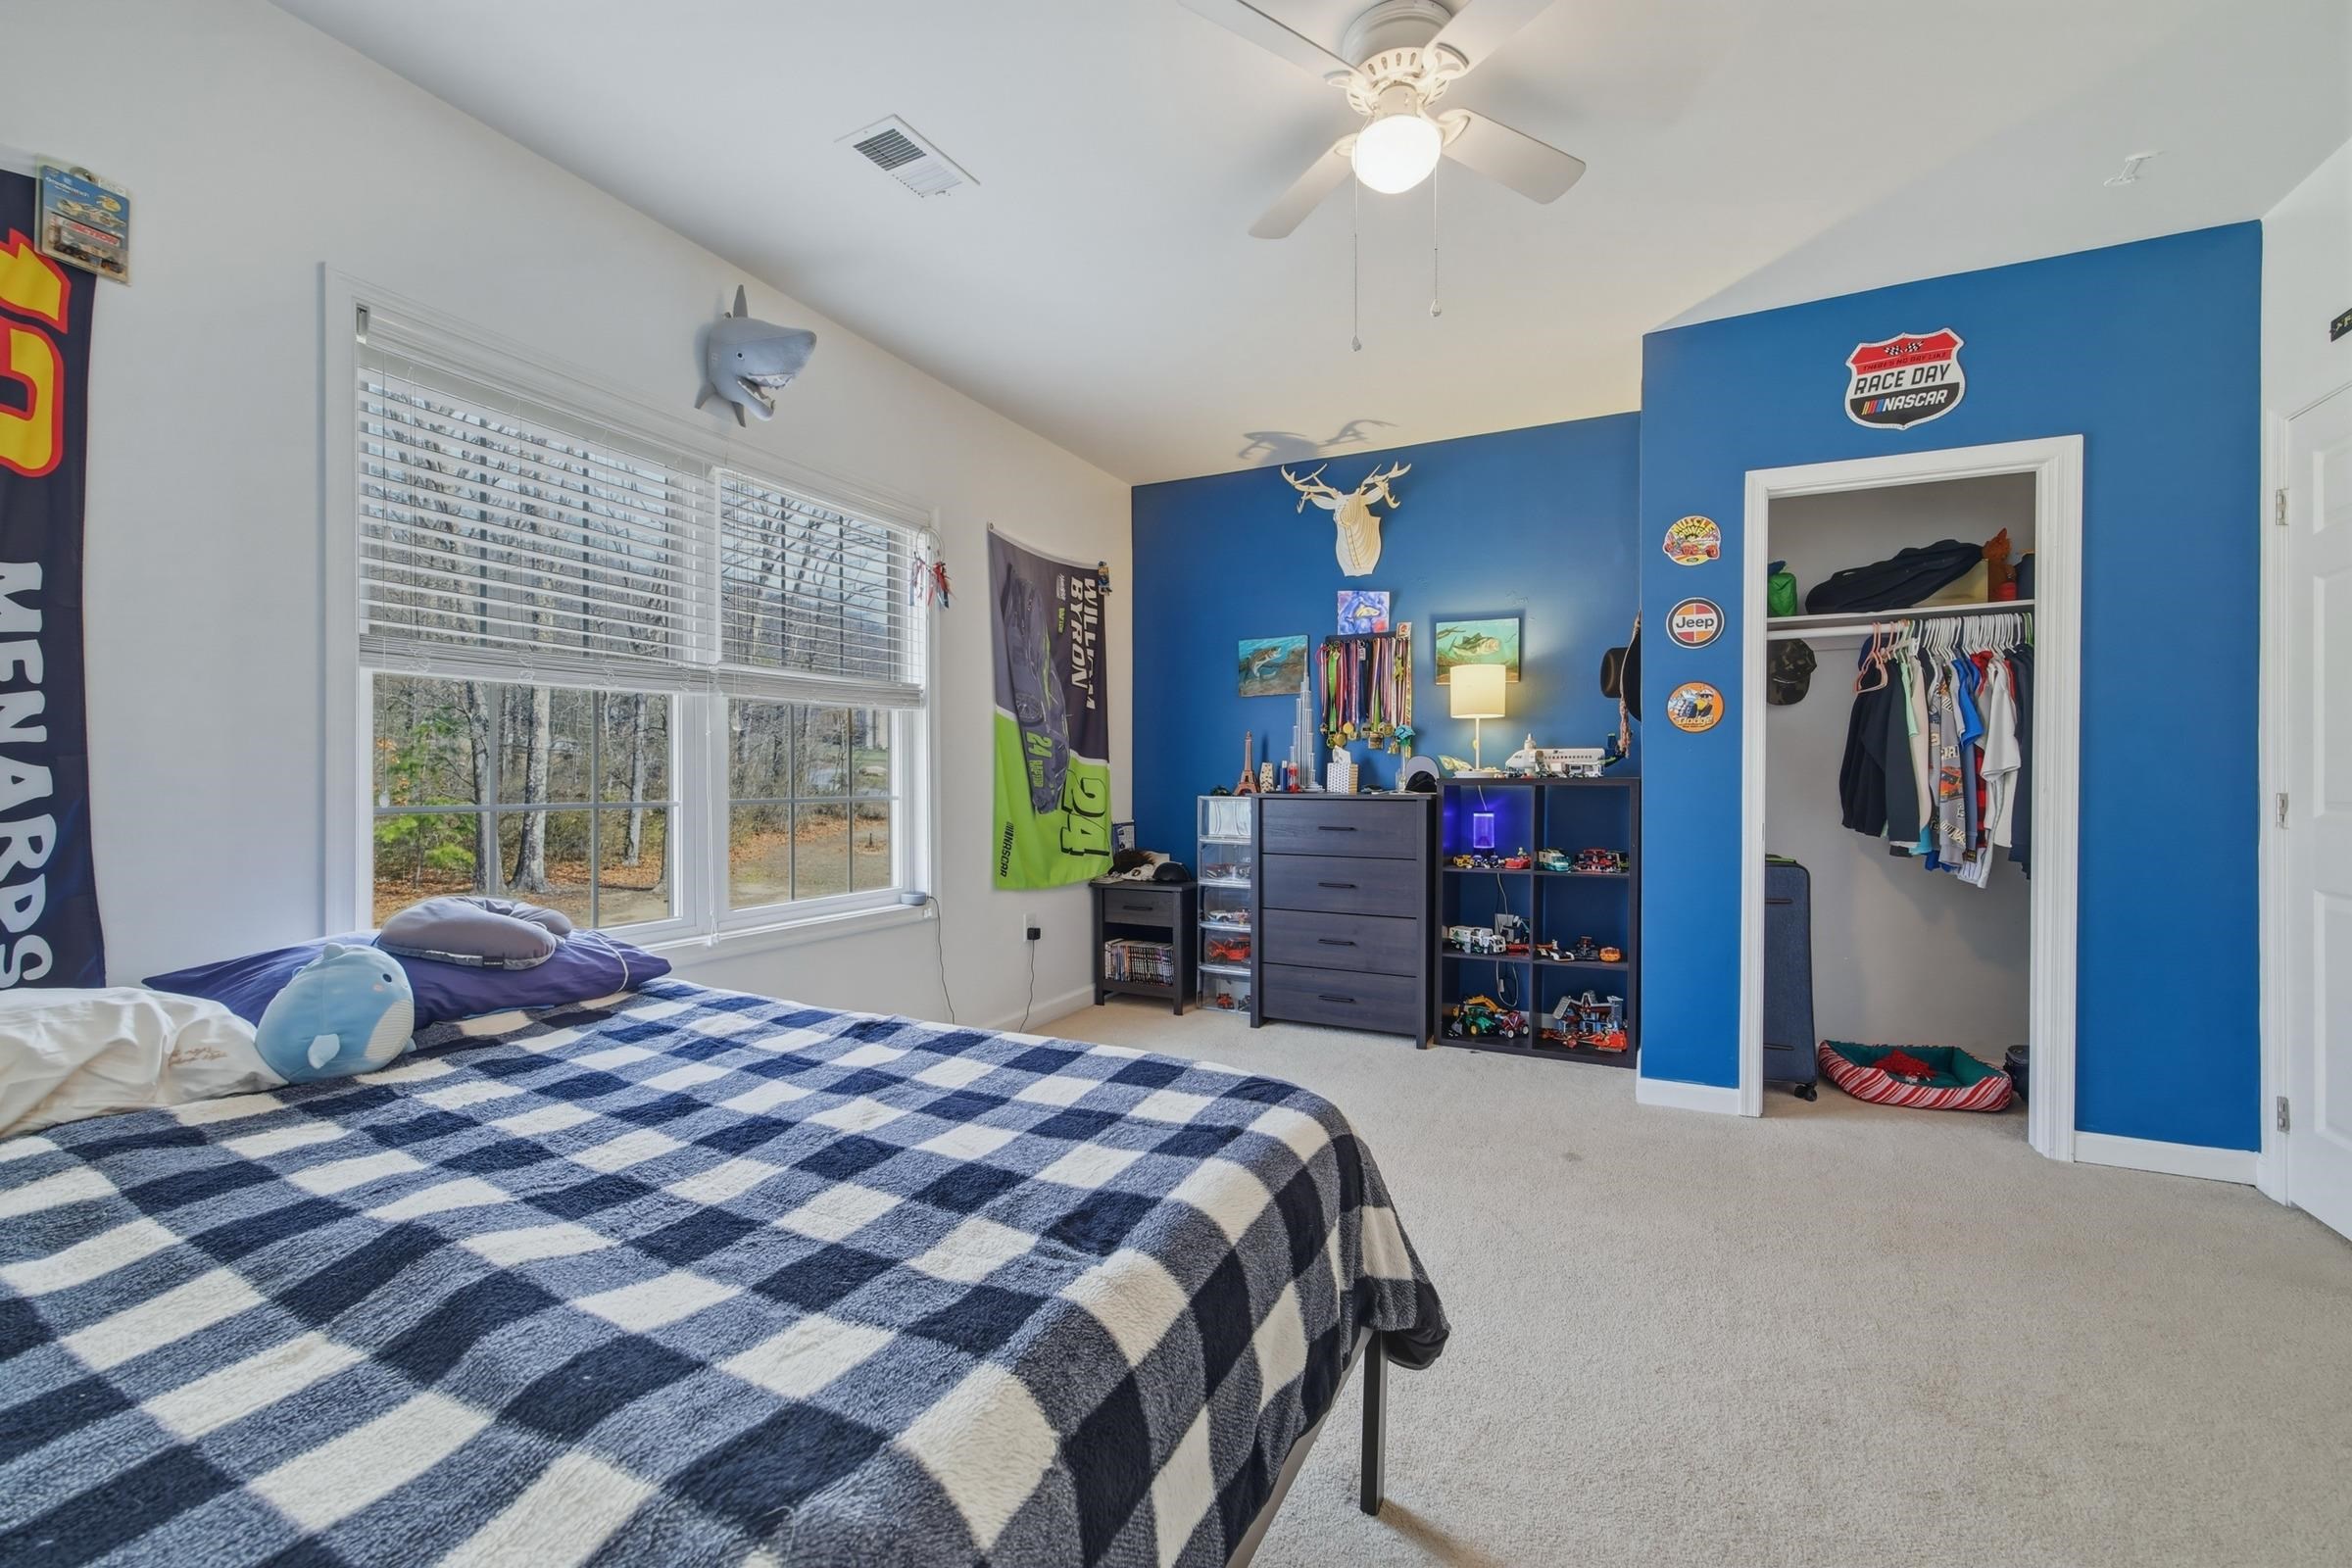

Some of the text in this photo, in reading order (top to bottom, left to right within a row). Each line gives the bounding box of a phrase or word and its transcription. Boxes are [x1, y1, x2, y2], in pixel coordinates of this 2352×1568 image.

[1854, 364, 1950, 395] RACE DAY
[1882, 389, 1948, 413] NASCAR
[1070, 576, 1088, 689] BYRON
[1676, 616, 1714, 629] Jeep
[1026, 731, 1054, 759] 24
[1060, 768, 1110, 857] 24
[1000, 831, 1014, 877] NASCAR
